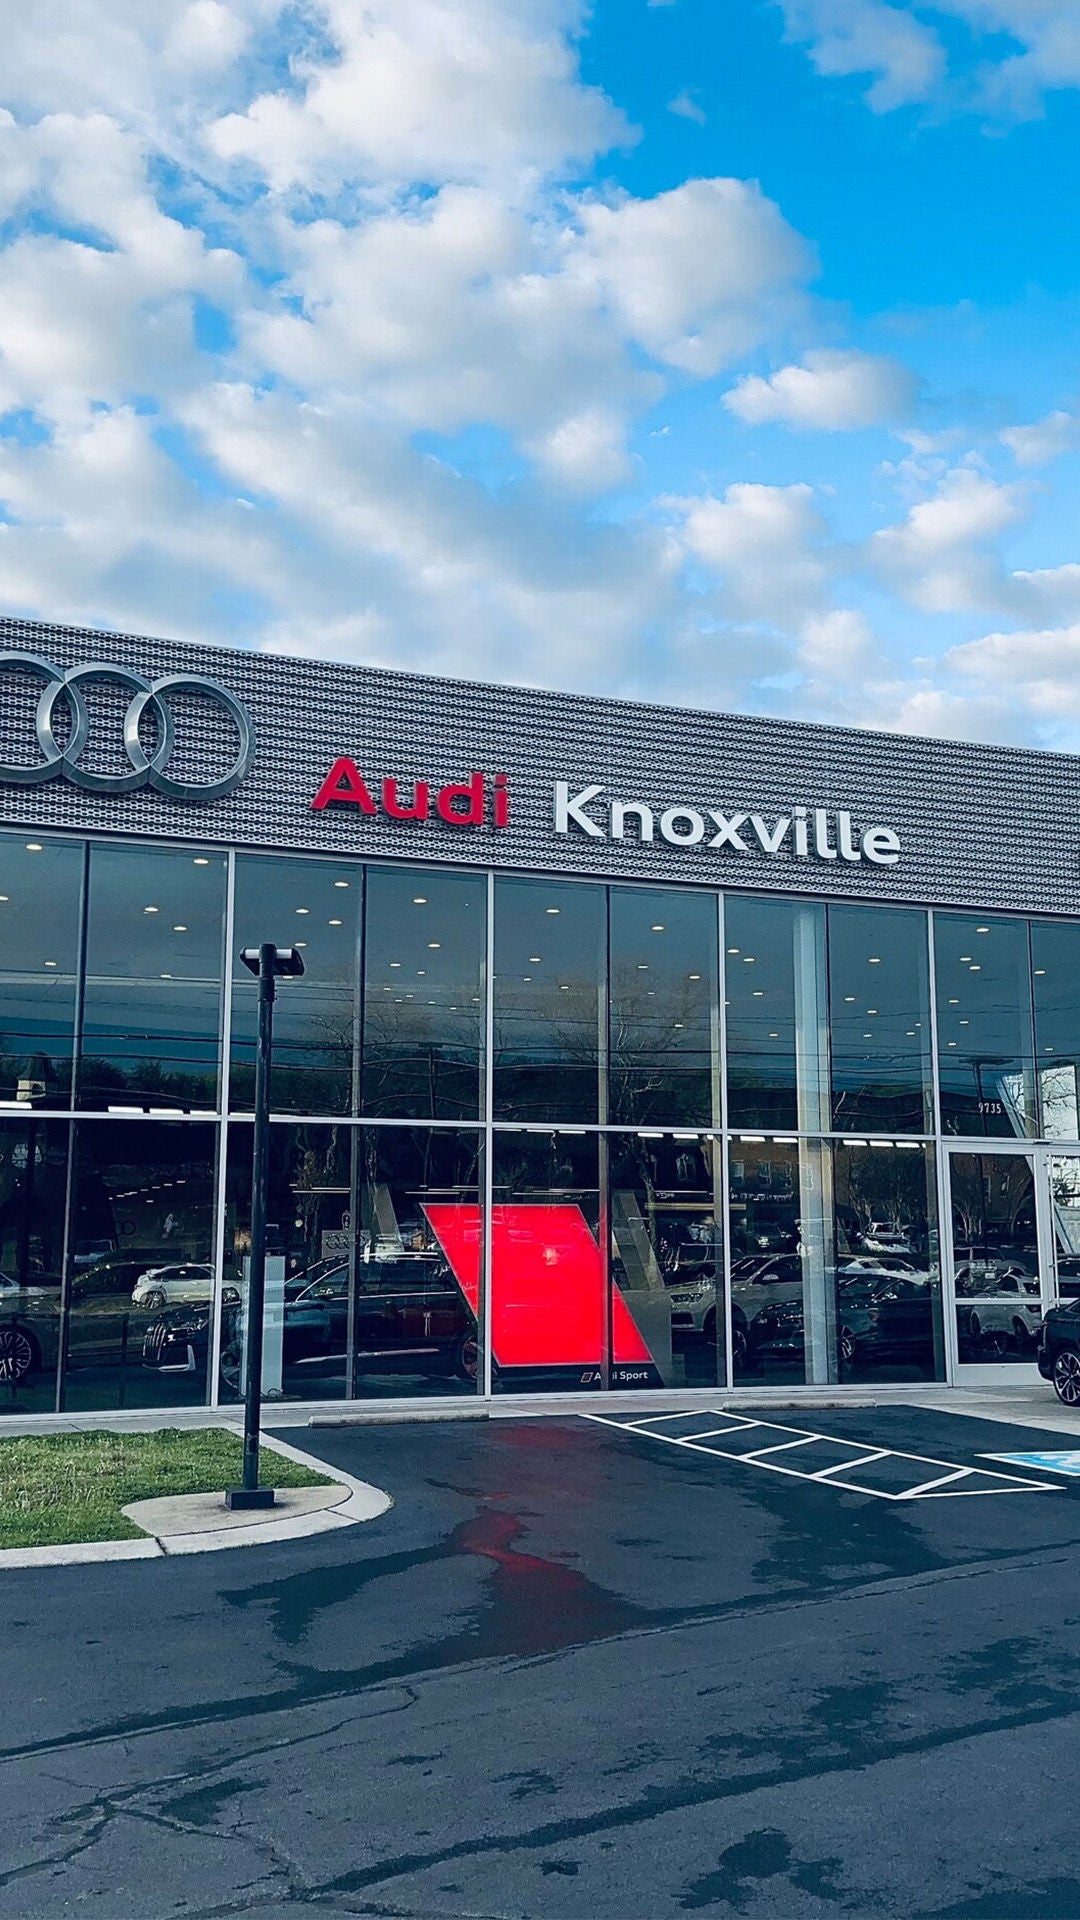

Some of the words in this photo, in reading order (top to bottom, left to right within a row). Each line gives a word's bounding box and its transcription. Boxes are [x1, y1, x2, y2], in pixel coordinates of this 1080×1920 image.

[310, 756, 508, 827] Audi
[553, 781, 902, 865] Knoxville
[978, 1102, 1001, 1114] 9735
[594, 1371, 618, 1381] Ai
[619, 1371, 649, 1381] Sport
